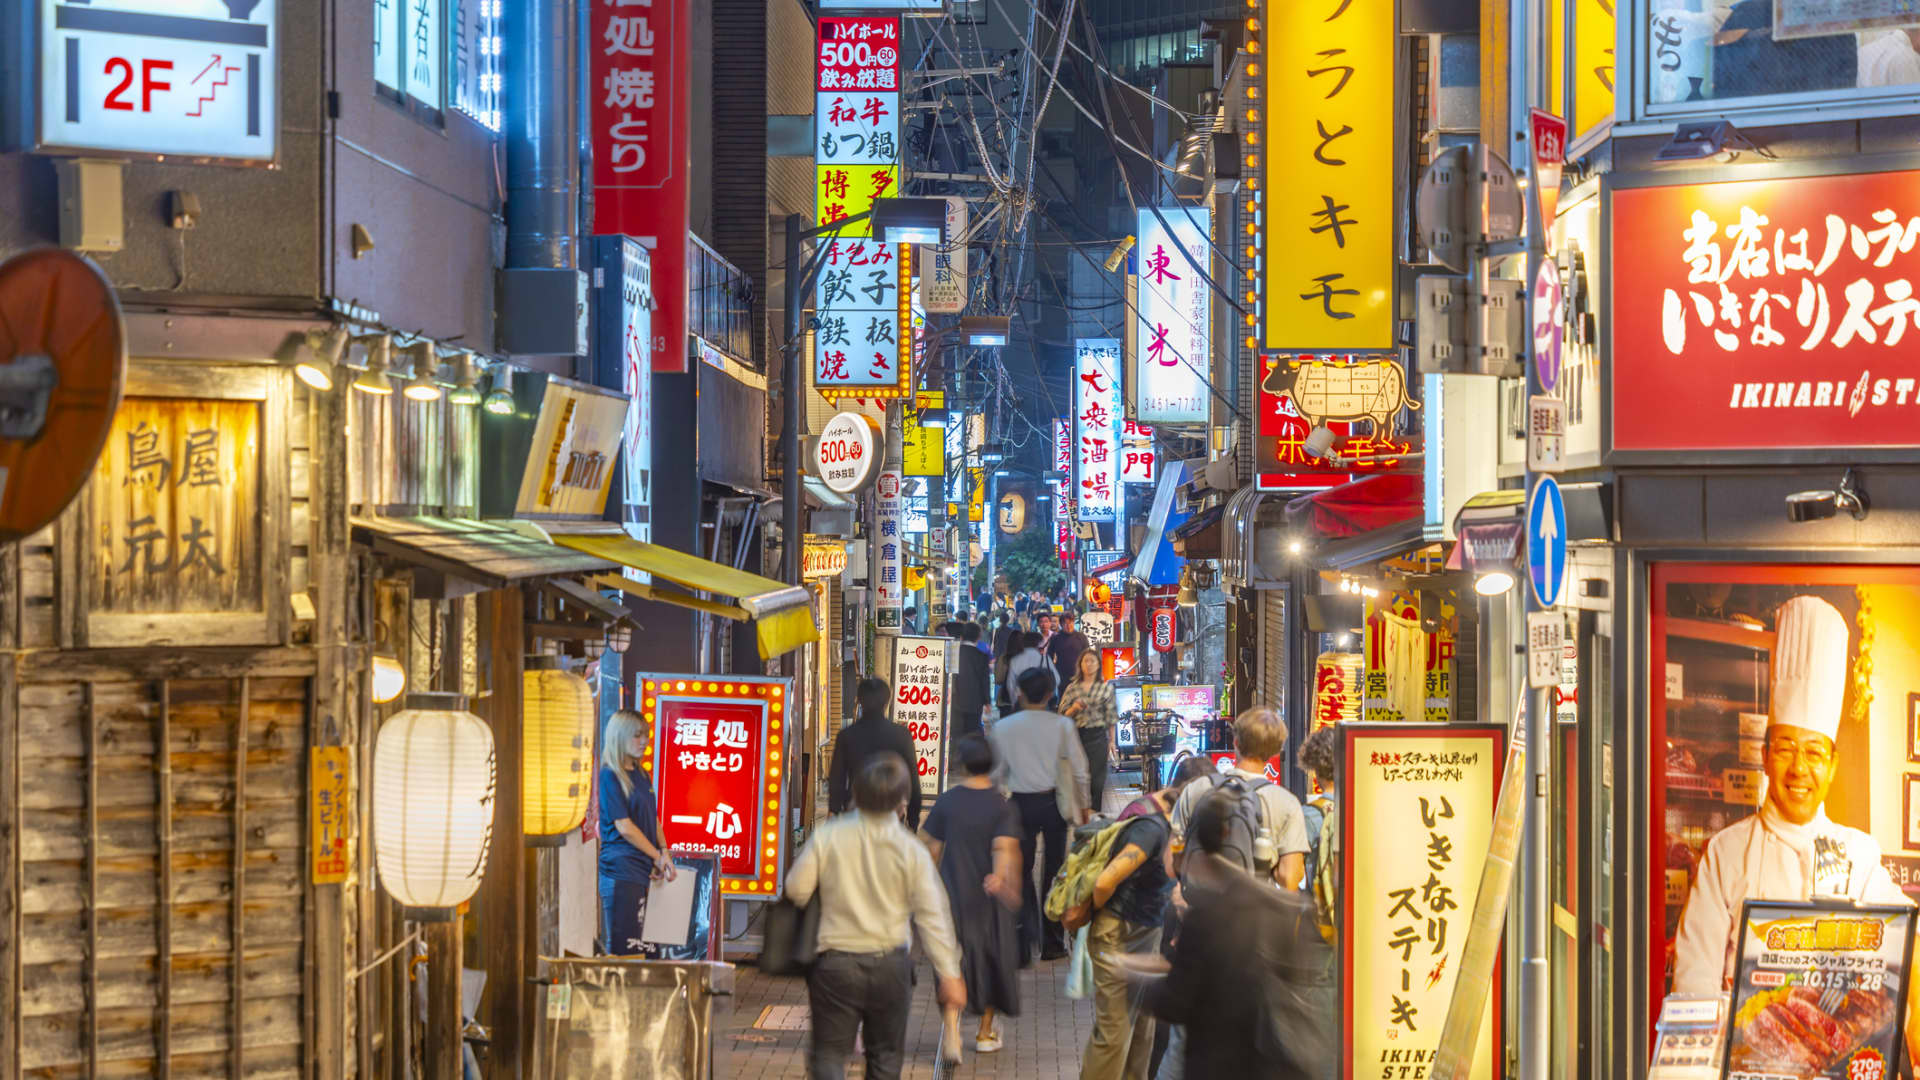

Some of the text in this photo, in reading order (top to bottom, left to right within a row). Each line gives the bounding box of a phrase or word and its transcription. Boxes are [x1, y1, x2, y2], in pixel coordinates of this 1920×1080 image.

[833, 22, 896, 40] ハイボール
[820, 42, 878, 67] 500円
[103, 56, 174, 113] 2F
[820, 68, 896, 88] 飲み放題
[828, 97, 890, 127] 和牛
[821, 131, 895, 160] もつ鍋
[821, 170, 893, 199] 博多
[828, 242, 893, 266] 手包み
[820, 269, 896, 306] 餃子
[1143, 243, 1182, 367] 東光
[821, 316, 896, 348] 鉄板
[820, 350, 892, 381] 焼き
[1730, 377, 1920, 409] IKINARI ST
[828, 426, 854, 437] ハイボール
[122, 421, 222, 492] 鳥屋
[1277, 433, 1412, 468] ホモン
[828, 467, 856, 481] 飲み放題
[117, 514, 226, 576] 元太
[881, 519, 897, 584] 横倉屋
[897, 685, 941, 706] 500円
[1367, 671, 1450, 693] 営時
[673, 718, 749, 749] 酒処
[677, 751, 743, 772] やきとり
[916, 757, 937, 777] 0円
[318, 788, 334, 858] 生ビール
[671, 802, 742, 840] 一心
[1420, 795, 1458, 956] いきなり
[1387, 887, 1423, 1033] ステーキ
[1802, 970, 1846, 989] 10.15
[1860, 973, 1883, 990] 28
[1380, 1049, 1437, 1063] IKINA
[1381, 1065, 1426, 1080] STE
